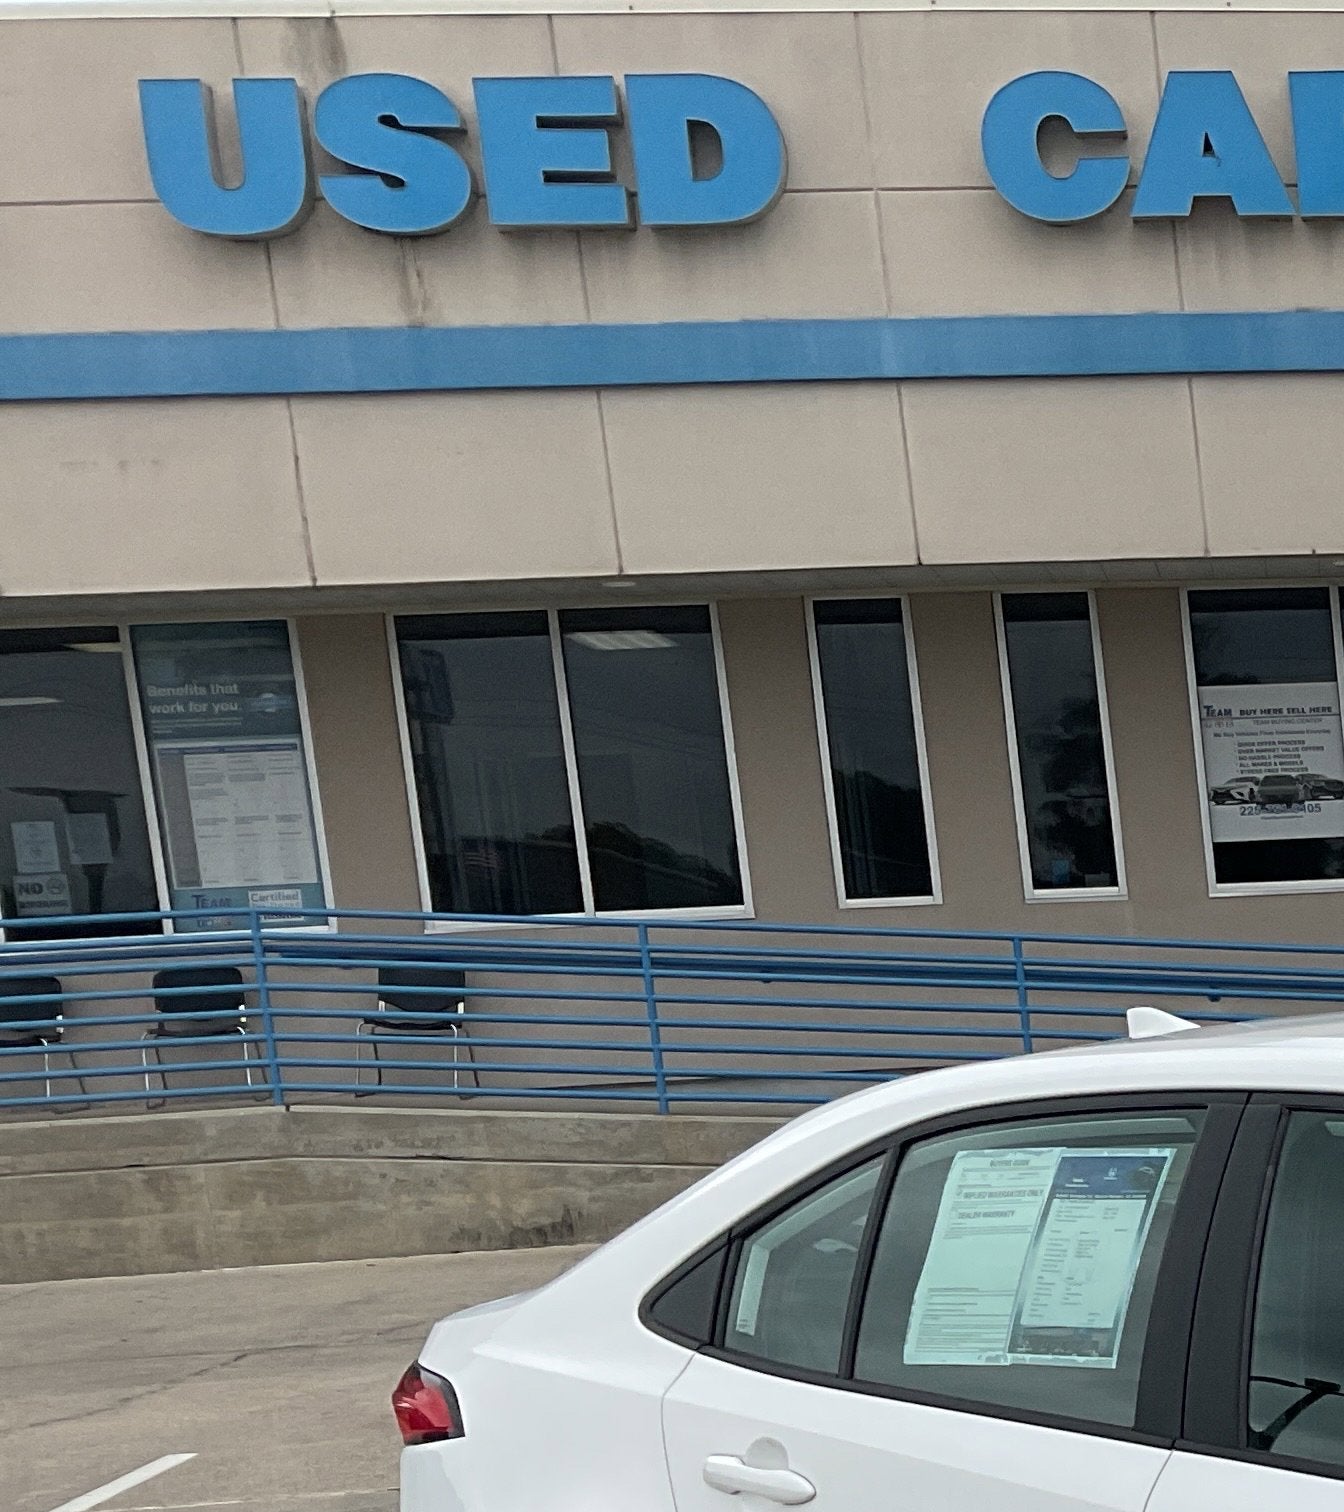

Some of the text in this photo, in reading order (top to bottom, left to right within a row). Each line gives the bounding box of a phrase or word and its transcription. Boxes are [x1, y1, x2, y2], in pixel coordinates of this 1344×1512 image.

[138, 72, 787, 239] USED
[147, 683, 240, 697] Benefits that
[148, 701, 185, 714] work
[189, 701, 208, 713] for
[1203, 705, 1332, 718] TEAM BUY HERE SELL HERE
[18, 882, 43, 895] NO
[251, 892, 299, 902] Certified
